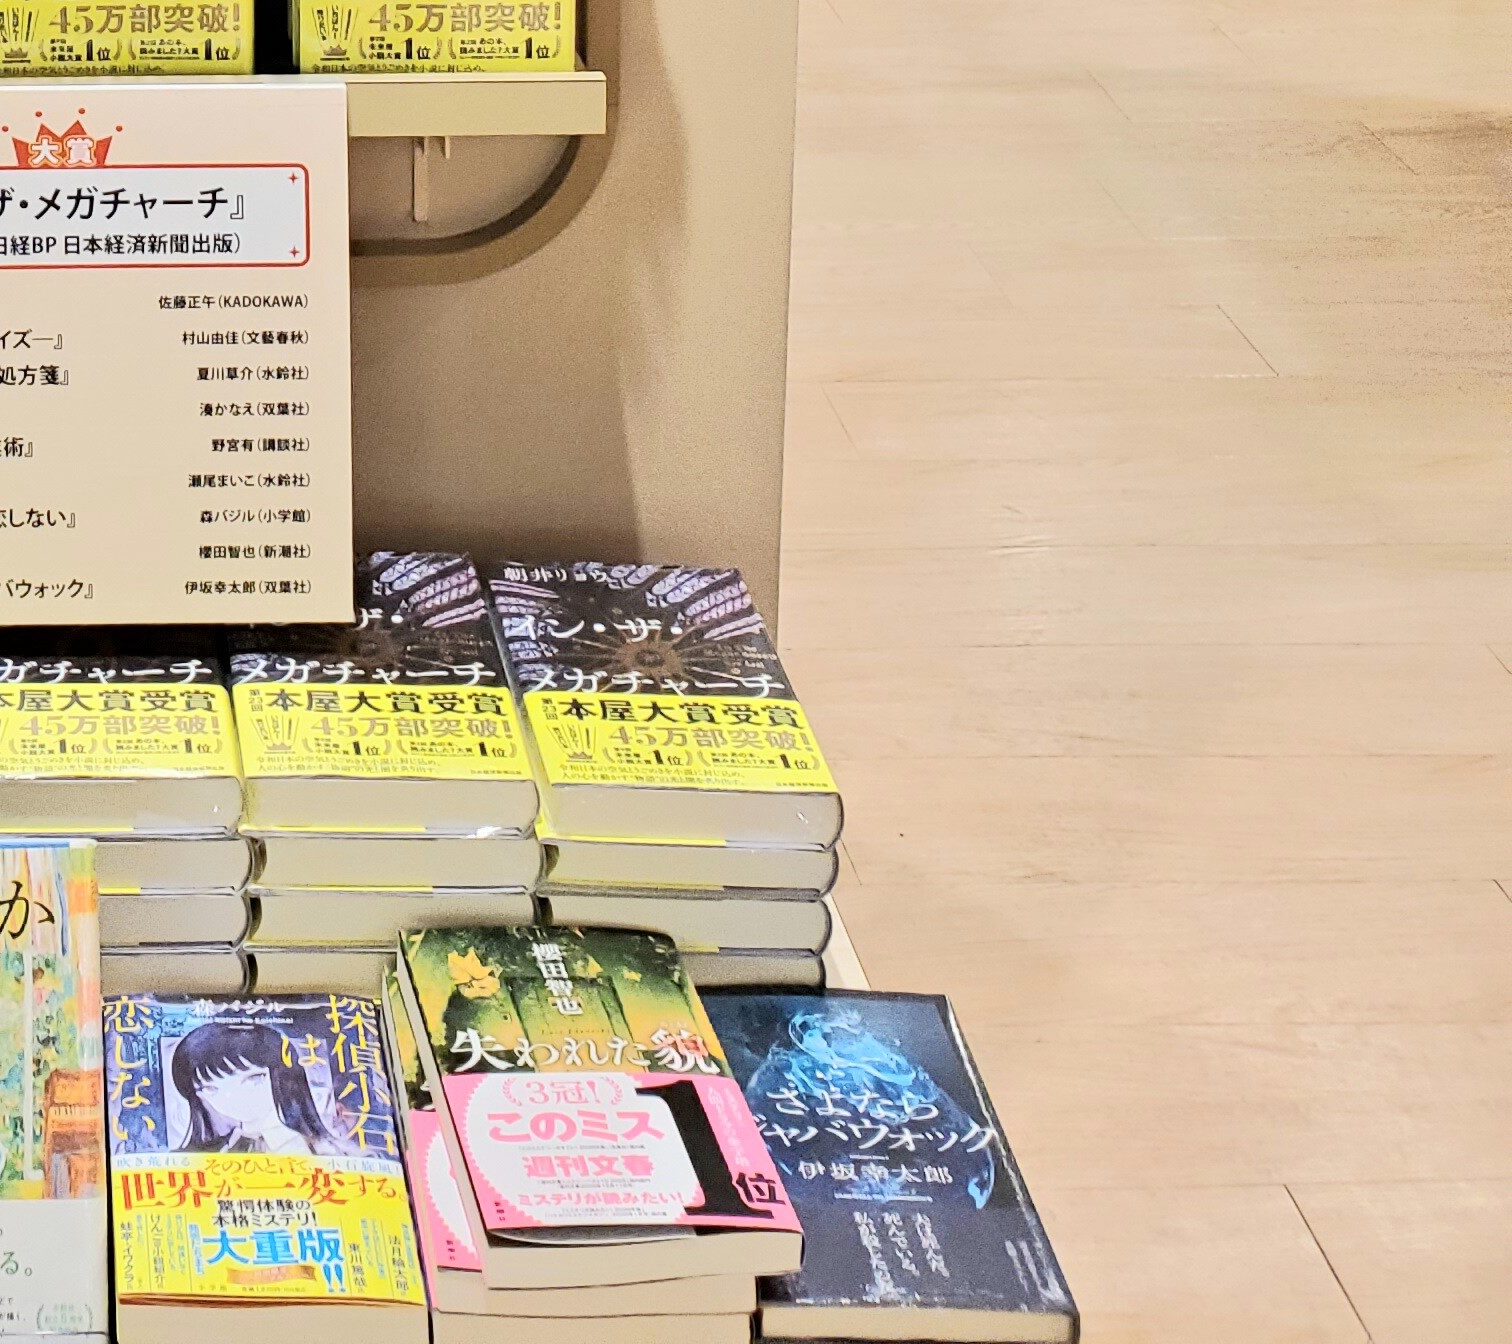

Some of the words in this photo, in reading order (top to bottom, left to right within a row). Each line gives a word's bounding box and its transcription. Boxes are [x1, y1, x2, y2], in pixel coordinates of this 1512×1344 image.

[369, 2, 561, 33] 45万部突破!
[30, 136, 95, 165] 大賞
[528, 668, 784, 698] メガチャーチ
[281, 1034, 326, 1067] は
[450, 1028, 720, 1075] 失われた貌
[103, 997, 155, 1141] 恋しない
[326, 995, 395, 1154] 探偵小石
[528, 1080, 600, 1105] 3冠!
[767, 1083, 939, 1120] さよなら
[487, 1111, 664, 1142] このミス
[523, 1156, 654, 1178] 週刊文春
[798, 1161, 953, 1185] 伊坂幸太郎
[121, 1169, 406, 1209] 世界が一変する。
[213, 1213, 317, 1227] 本格ミステリ!
